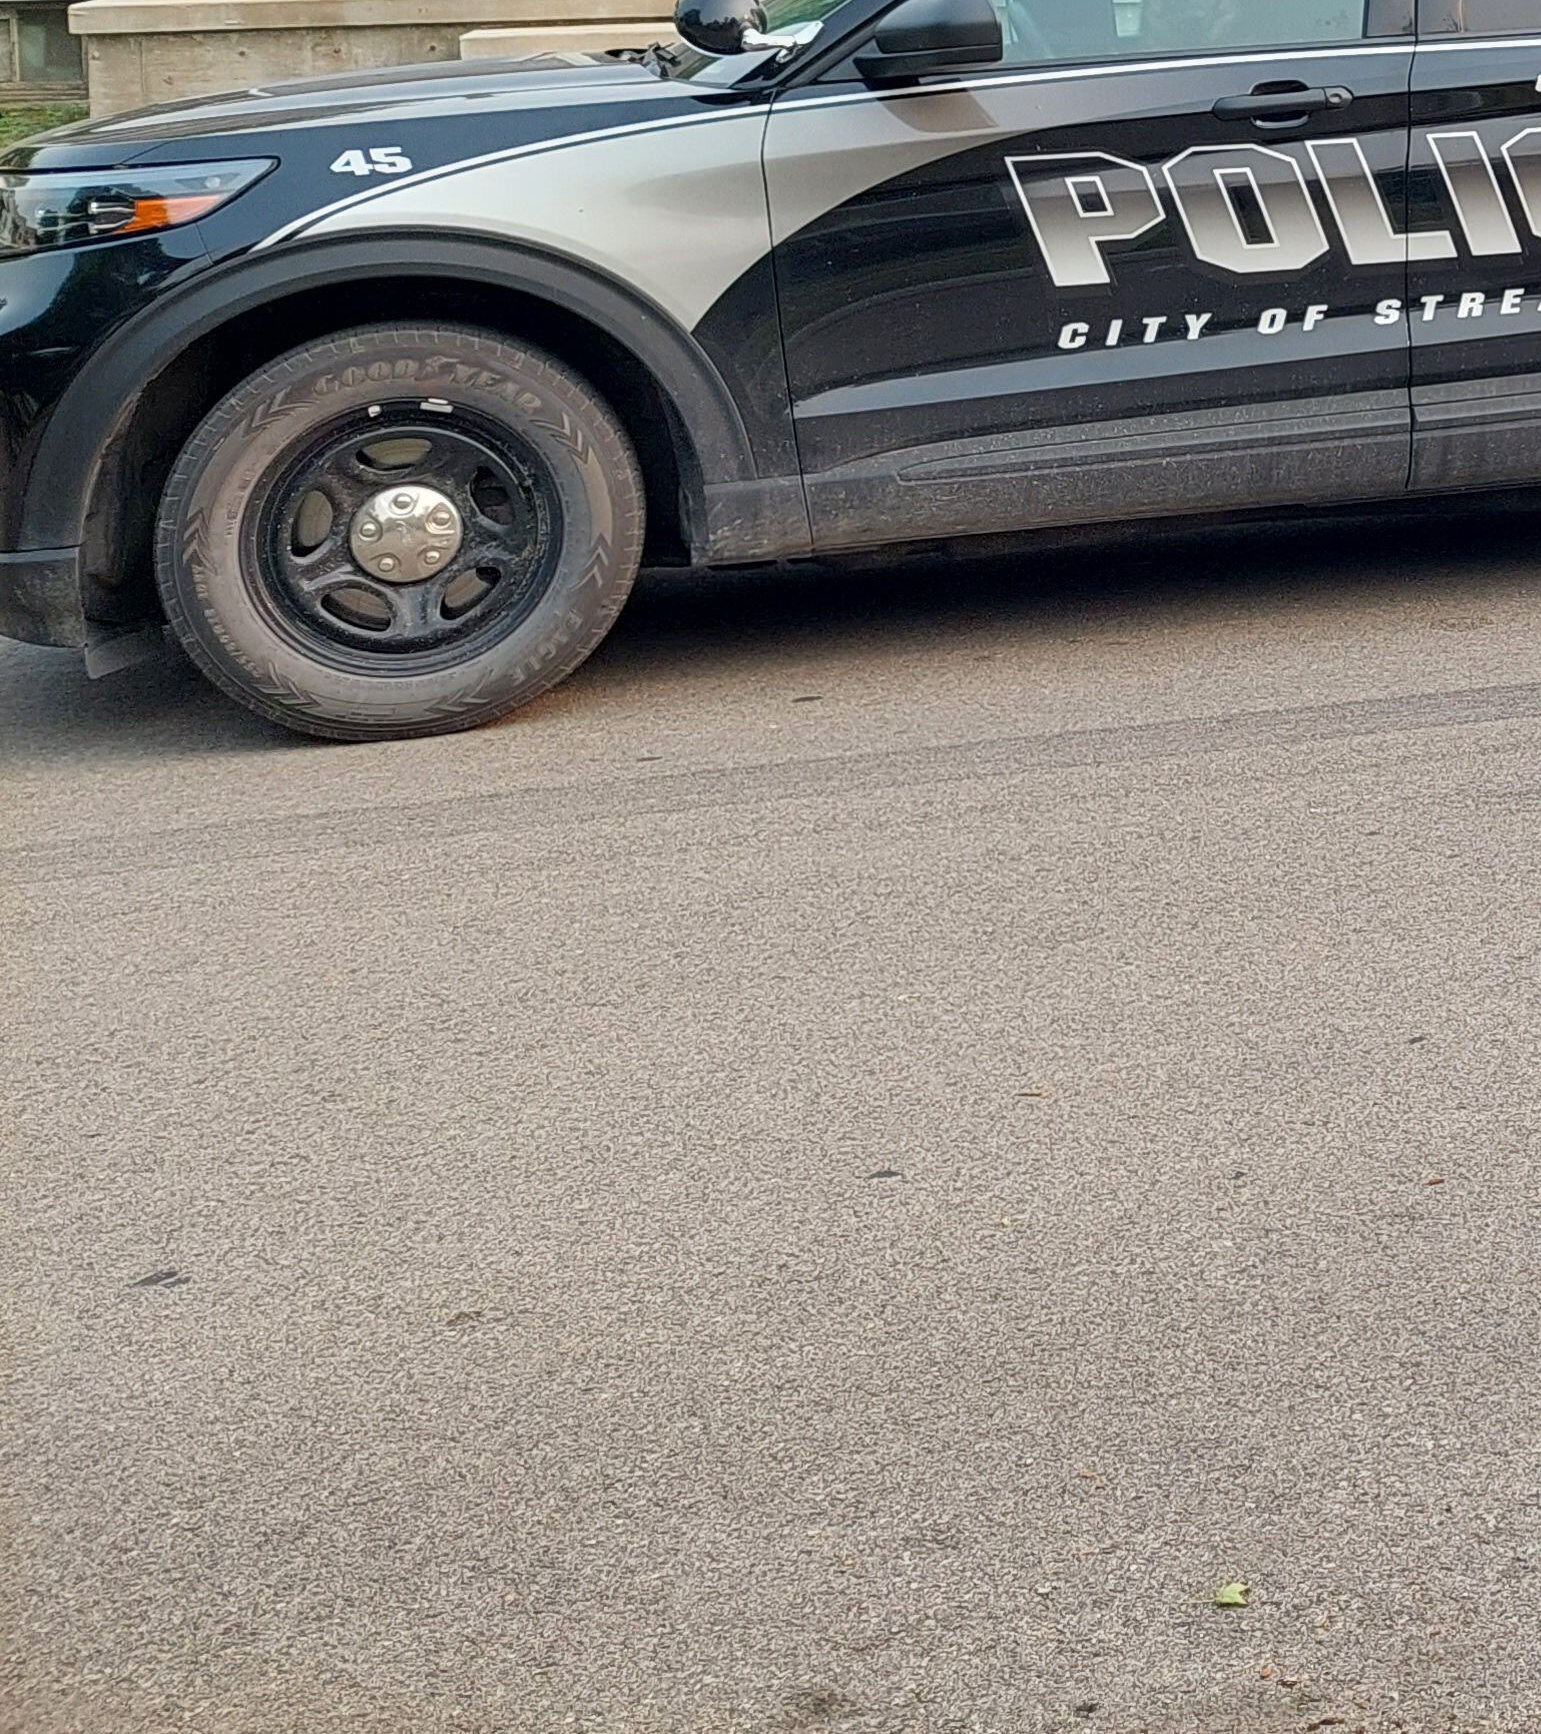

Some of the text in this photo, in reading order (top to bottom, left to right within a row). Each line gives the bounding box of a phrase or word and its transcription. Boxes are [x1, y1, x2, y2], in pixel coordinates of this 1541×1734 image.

[329, 146, 413, 176] 45
[1057, 311, 1213, 350] CITY
[1256, 305, 1329, 335] OF
